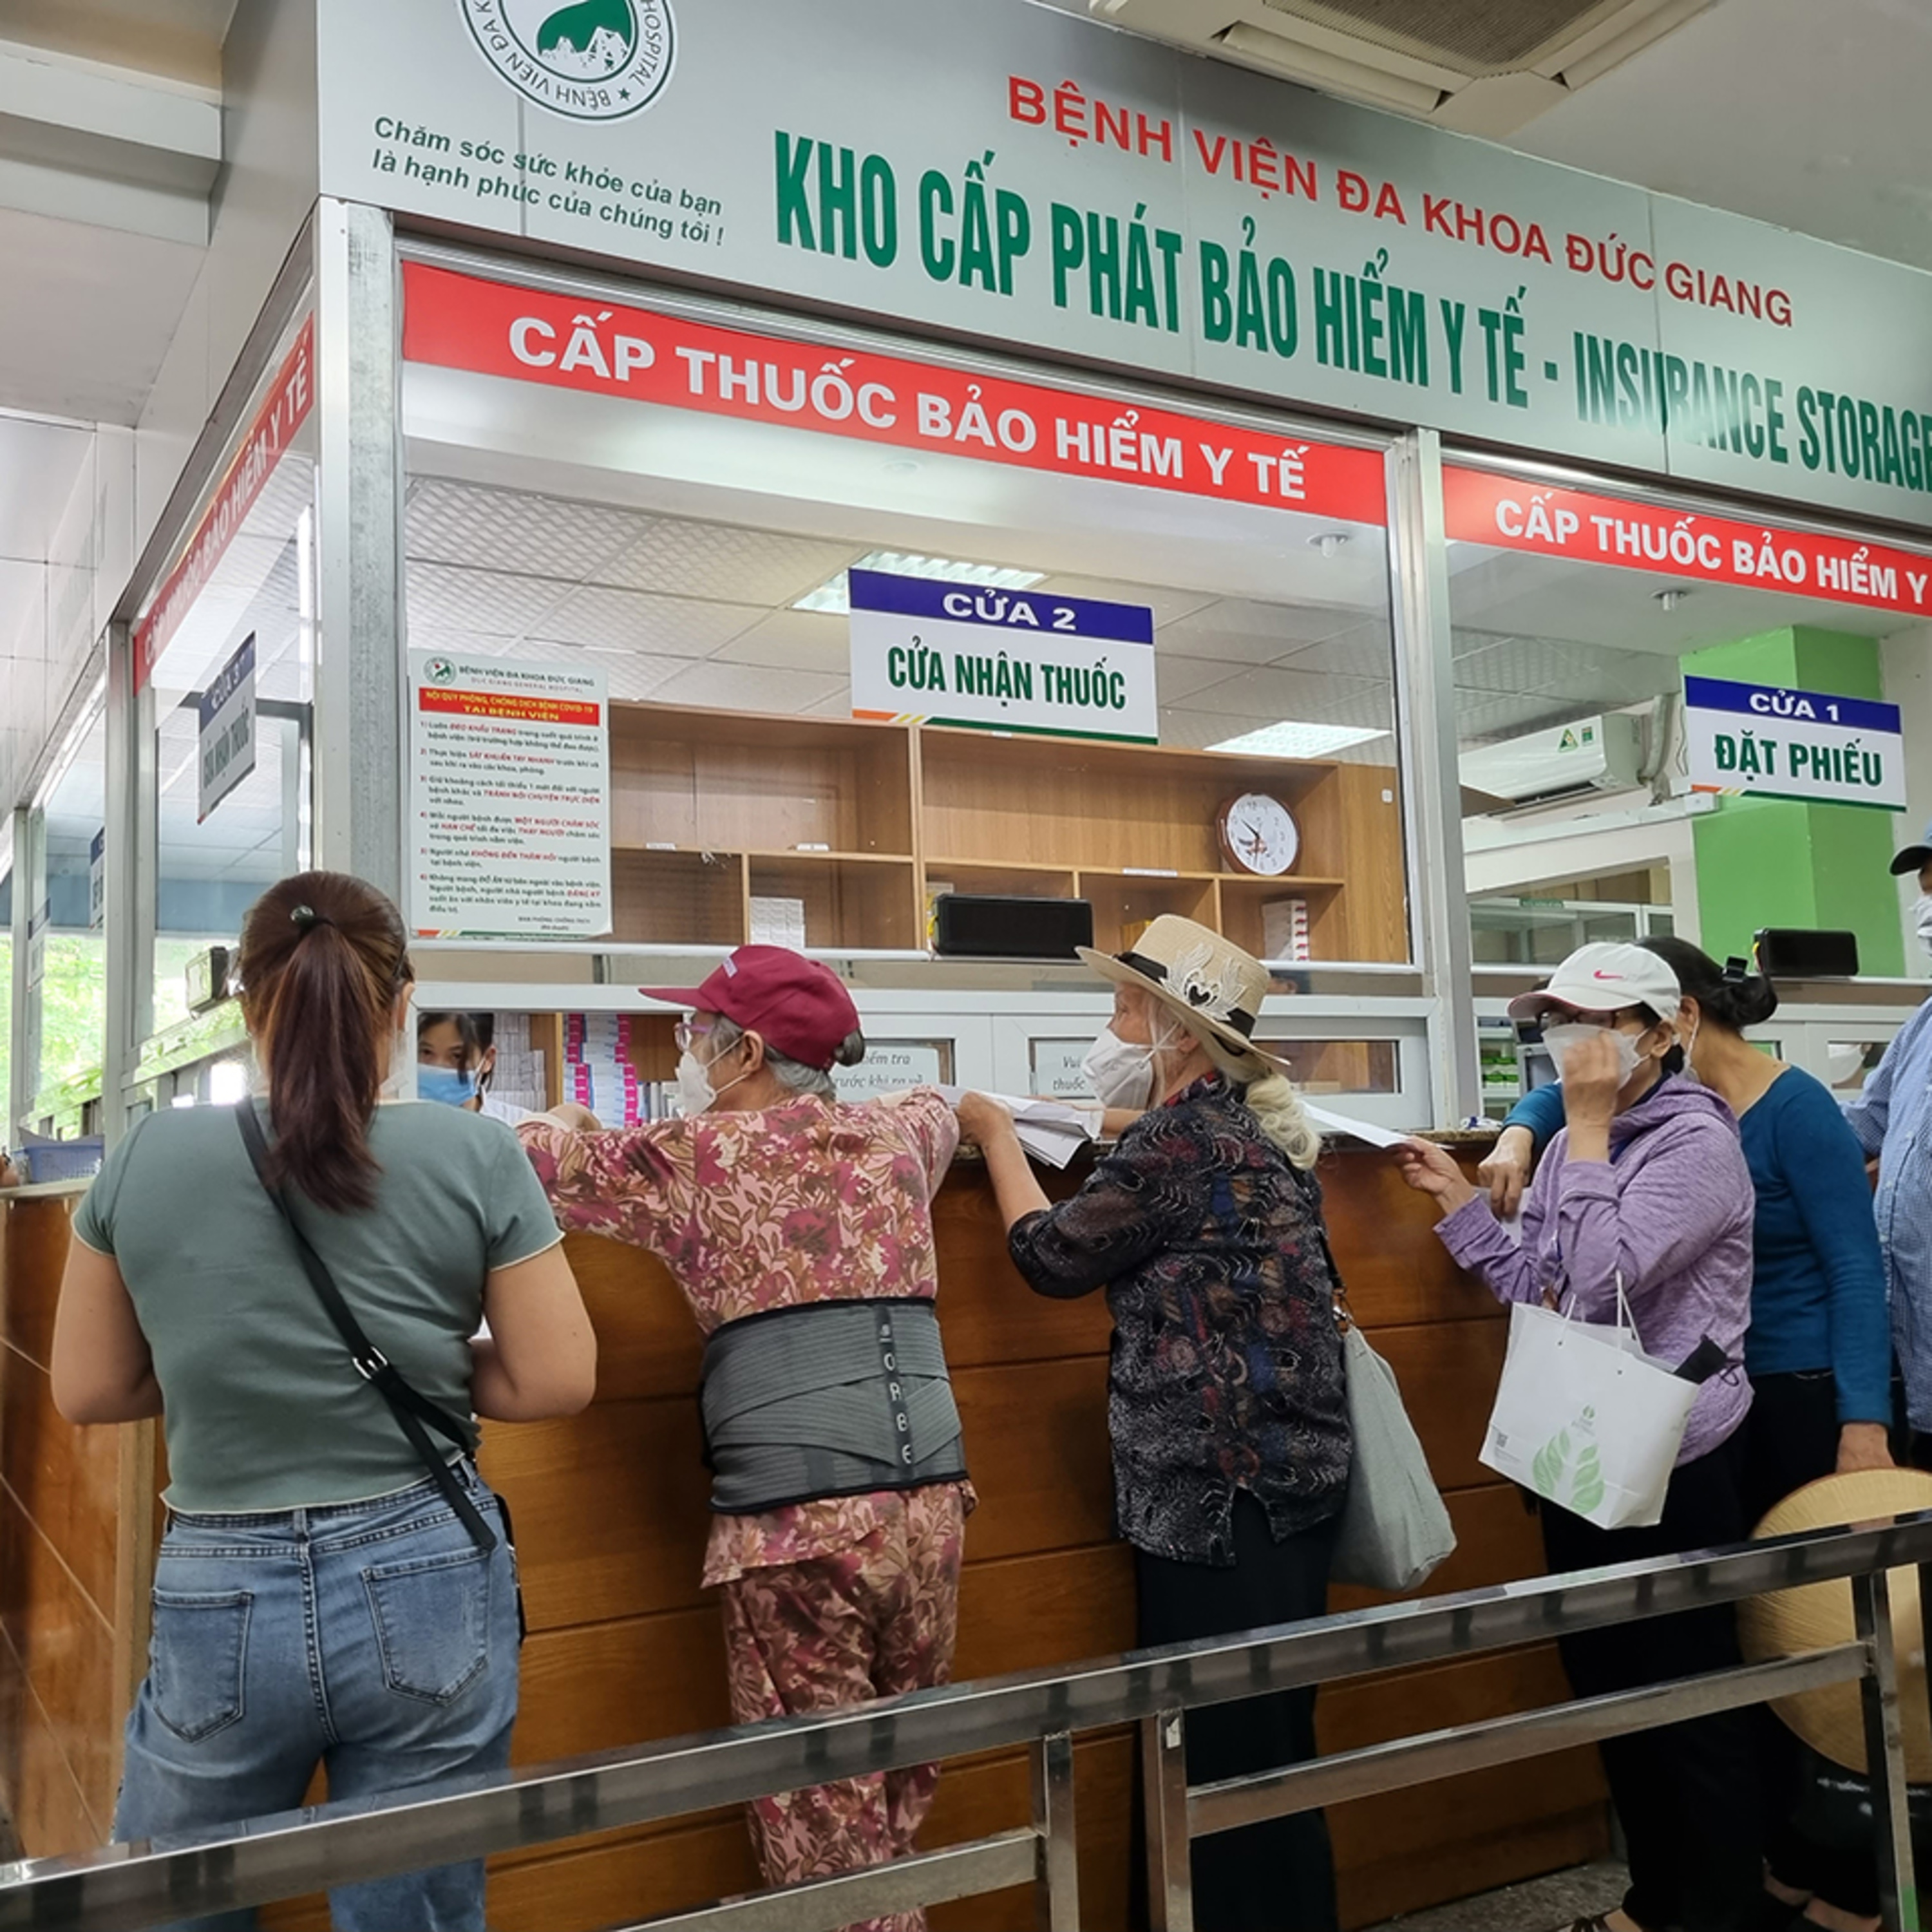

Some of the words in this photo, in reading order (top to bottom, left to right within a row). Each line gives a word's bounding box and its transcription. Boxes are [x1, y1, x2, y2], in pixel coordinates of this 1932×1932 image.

[372, 148, 397, 173] là
[404, 153, 469, 188] hạnh
[477, 175, 541, 205] phúc
[548, 189, 592, 217] của
[599, 201, 674, 239] chúng
[679, 217, 710, 244] tôi
[374, 116, 451, 153] Chăm
[459, 137, 505, 165] sóc
[512, 152, 558, 178] sức
[565, 161, 623, 193] khỏe
[630, 178, 676, 206] của
[679, 188, 723, 218] bạn
[1009, 75, 1172, 164] BỆNH
[1193, 129, 1318, 202] VIỆN
[1336, 169, 1406, 224] ĐA
[1422, 193, 1551, 263] KHOA
[1566, 229, 1655, 291] ĐỨC
[1665, 261, 1794, 327] GIANG
[775, 129, 898, 269] KHO
[918, 150, 1031, 297] CẤP
[1050, 202, 1183, 334] PHÁT
[1199, 215, 1298, 359] BẢO
[1312, 247, 1430, 388] HIỂM
[1439, 297, 1466, 395] Y
[1478, 285, 1529, 410] TẾ
[1543, 359, 1559, 381] -
[1573, 331, 1789, 464] INSURANCE
[509, 310, 656, 383] CẤP
[675, 346, 897, 428] THUỐC
[916, 384, 1037, 453] BẢO
[1055, 410, 1184, 478] HIỂM
[1199, 443, 1234, 486] Y
[1247, 446, 1310, 500] TẾ
[1495, 492, 1580, 547] CẤP
[1589, 516, 1722, 569] THUỐC
[1732, 531, 1806, 583] BẢO
[1817, 547, 1898, 600] HIỂM
[1906, 571, 1929, 605] Y
[942, 589, 1040, 627] CỬA
[1052, 607, 1078, 631] 2
[887, 635, 946, 692] CỬA
[954, 652, 1032, 707] NHẬN
[1040, 656, 1126, 710] THUỐC
[1750, 690, 1815, 719] CỬA
[1826, 703, 1841, 722] 1
[1714, 729, 1777, 781] ĐẶT
[1788, 737, 1883, 787] PHIẾU
[835, 1074, 866, 1087] rước
[891, 1054, 911, 1065] tra
